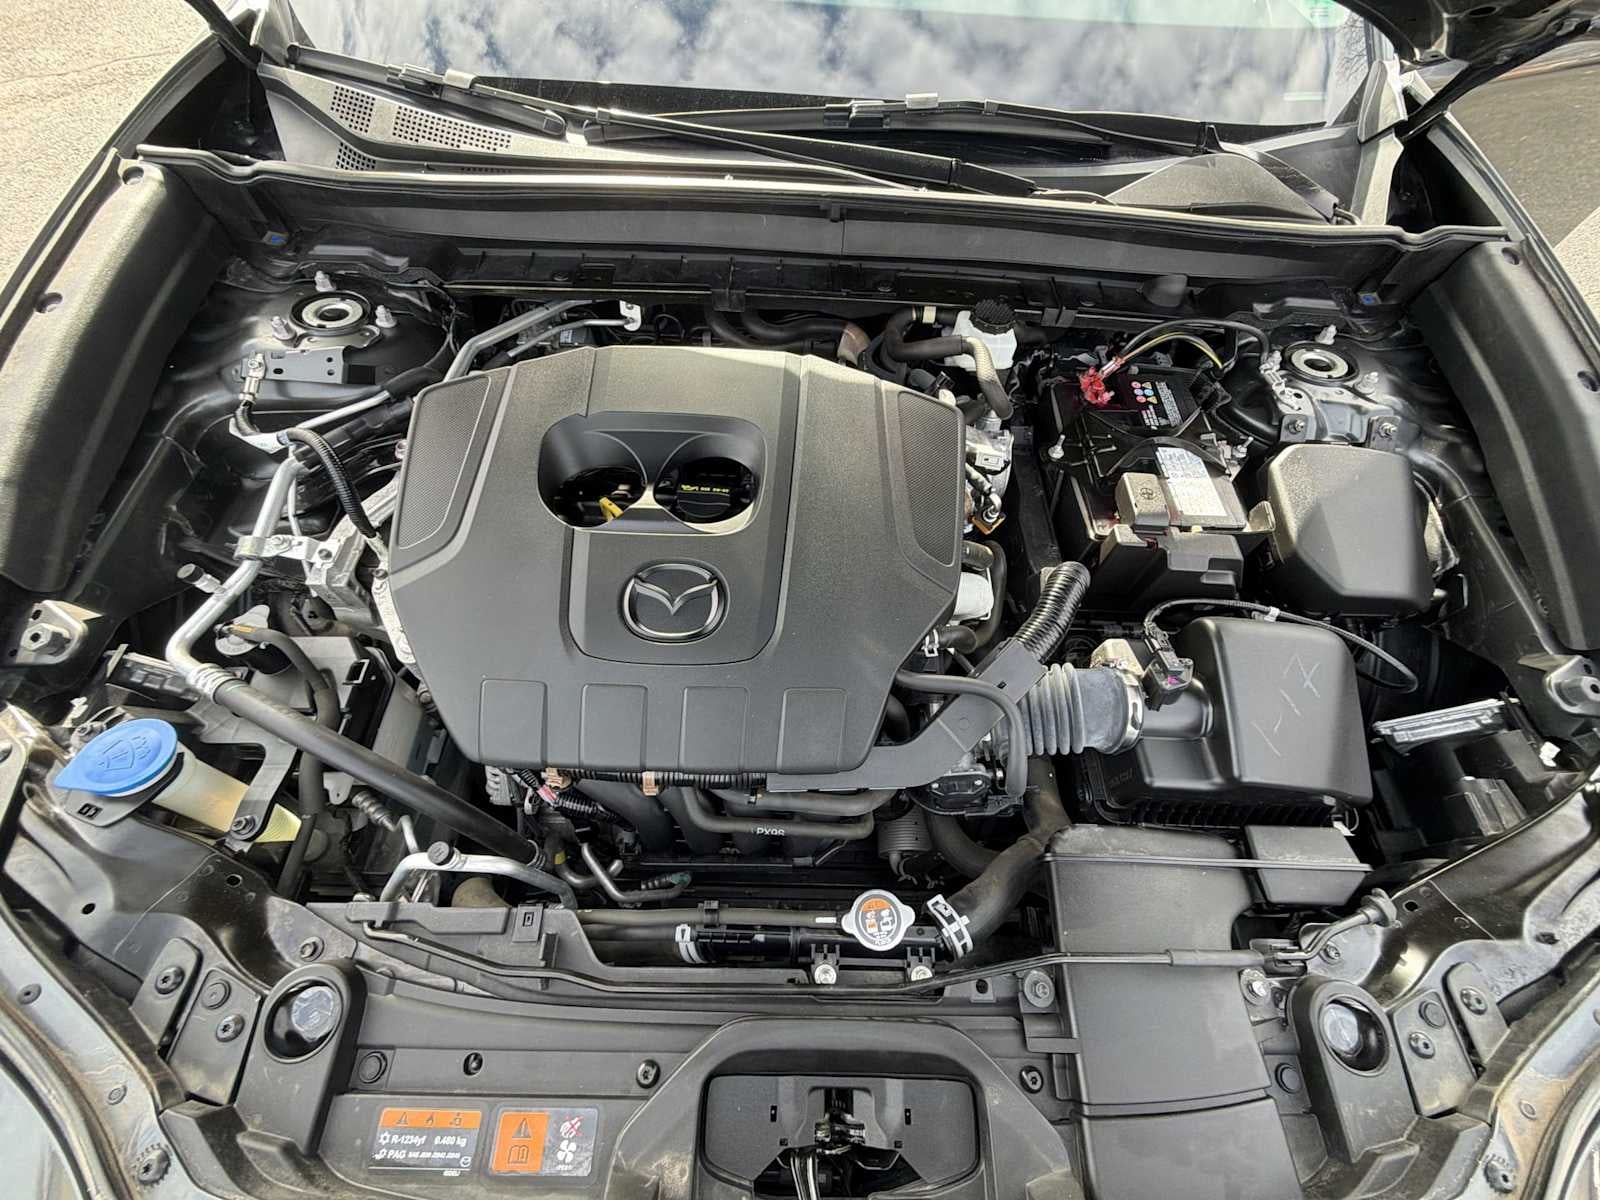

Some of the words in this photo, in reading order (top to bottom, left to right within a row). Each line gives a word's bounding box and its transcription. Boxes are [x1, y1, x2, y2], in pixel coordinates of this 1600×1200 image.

[391, 1134, 427, 1147] R-1234yf
[456, 1135, 468, 1147] kg
[387, 1150, 406, 1159] PAG
